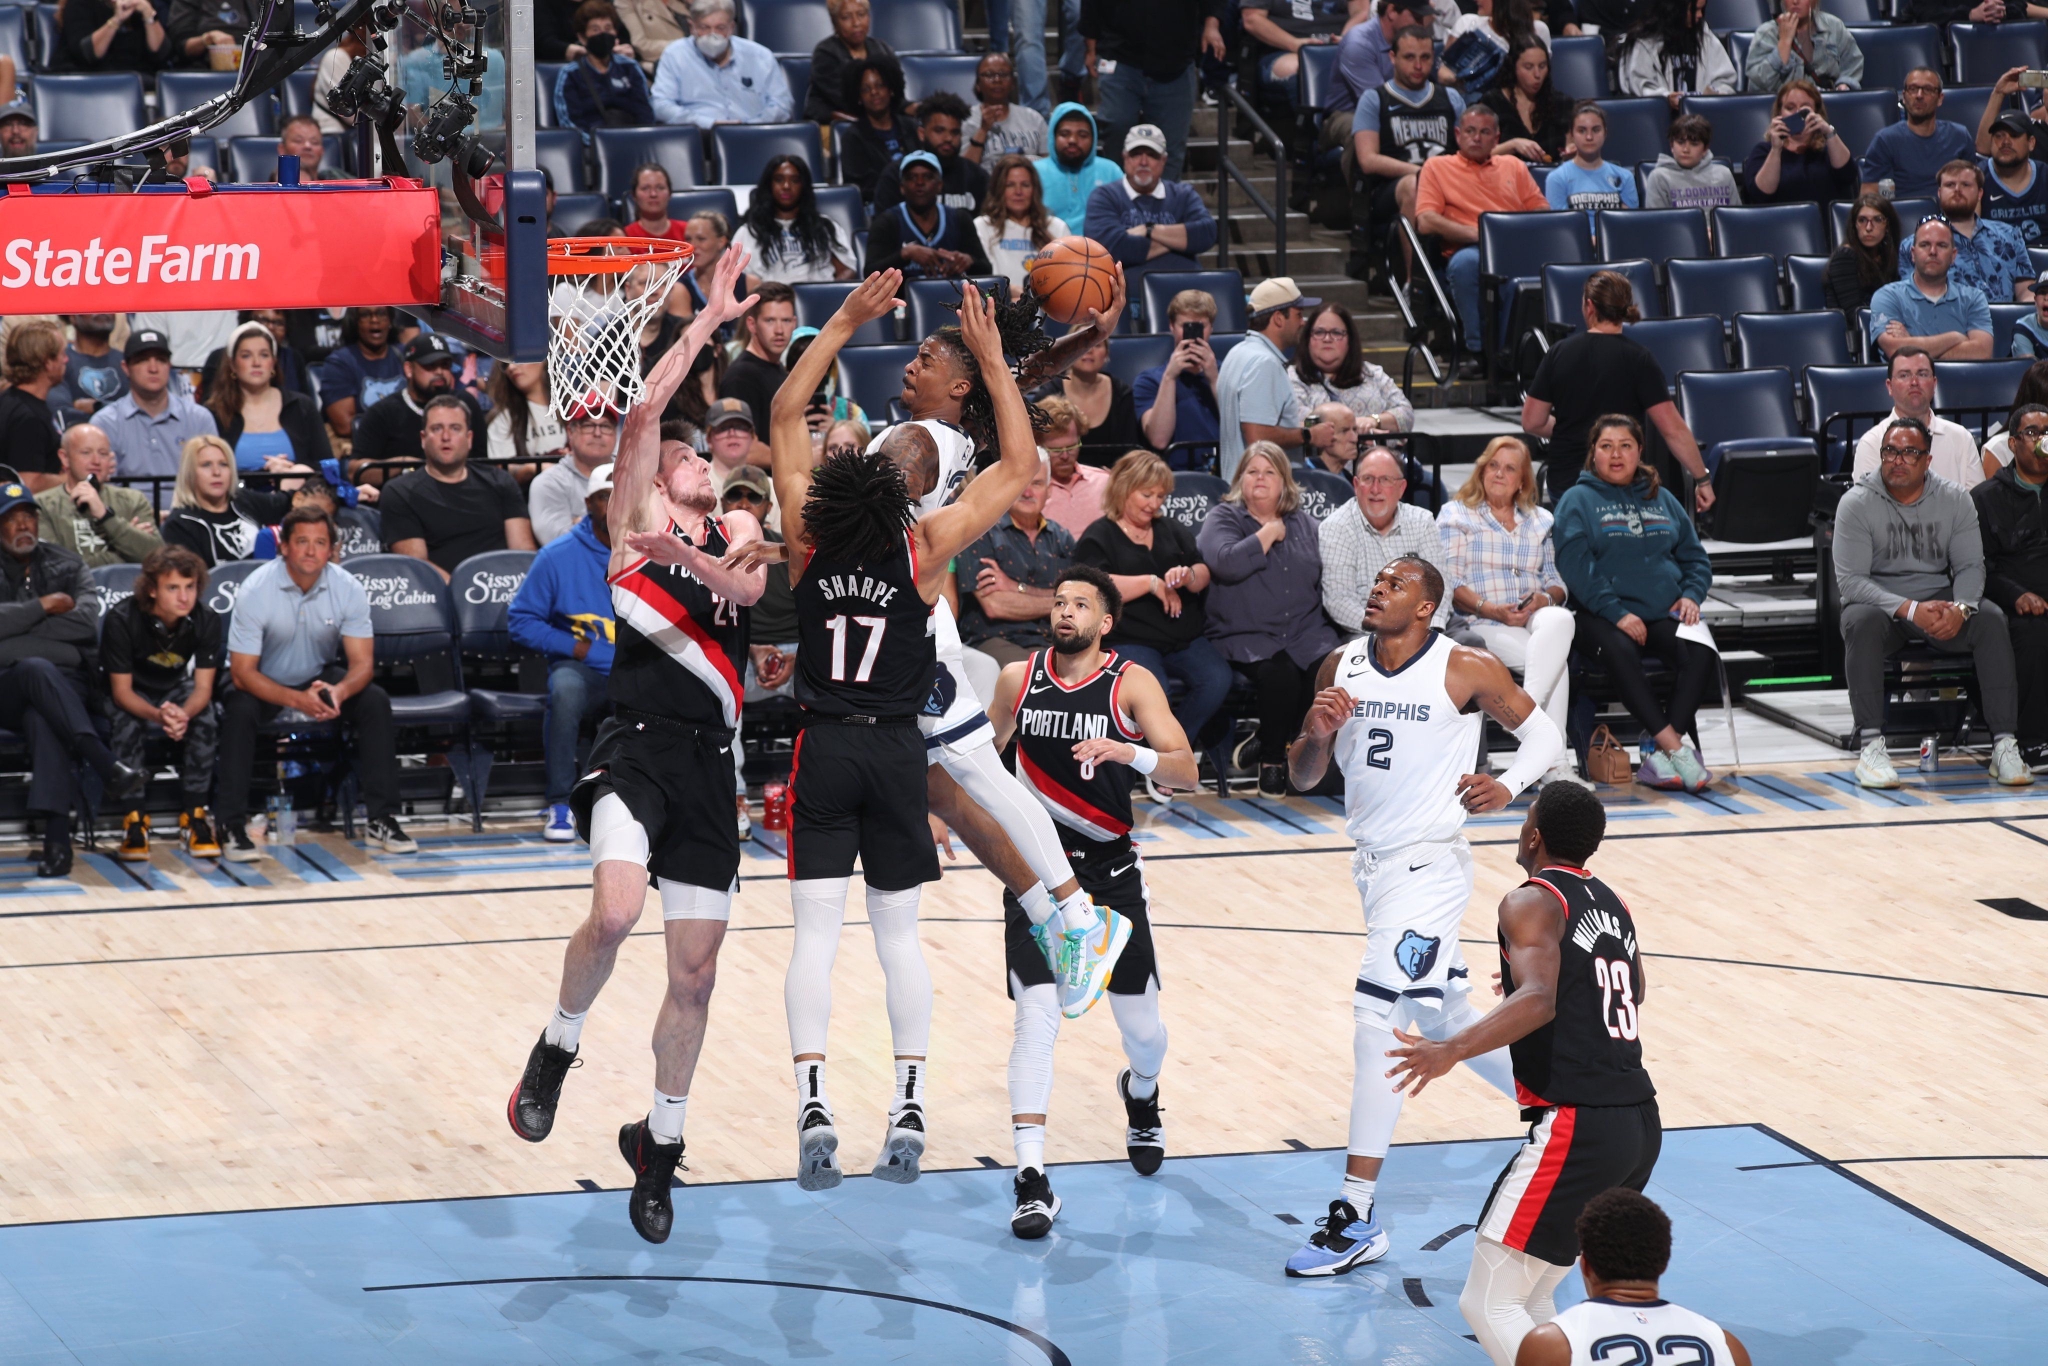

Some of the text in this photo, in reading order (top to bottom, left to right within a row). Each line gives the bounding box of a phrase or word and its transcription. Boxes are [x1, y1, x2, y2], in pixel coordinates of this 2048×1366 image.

[1390, 115, 1448, 146] MEMPHIS
[1570, 193, 1620, 205] MEMPHIS
[1990, 204, 2047, 218] GRIZZLIES
[367, 589, 437, 610] Log Cabin
[464, 571, 526, 605] Sissy'
[818, 575, 899, 608] SHARPE
[711, 591, 738, 627] 24
[825, 612, 888, 683] 17
[1035, 669, 1044, 681] 6
[1021, 707, 1109, 741] PORTLAND
[1366, 727, 1394, 771] 2
[1572, 908, 1637, 961] WILLIAMS JR
[1594, 956, 1638, 1042] 23
